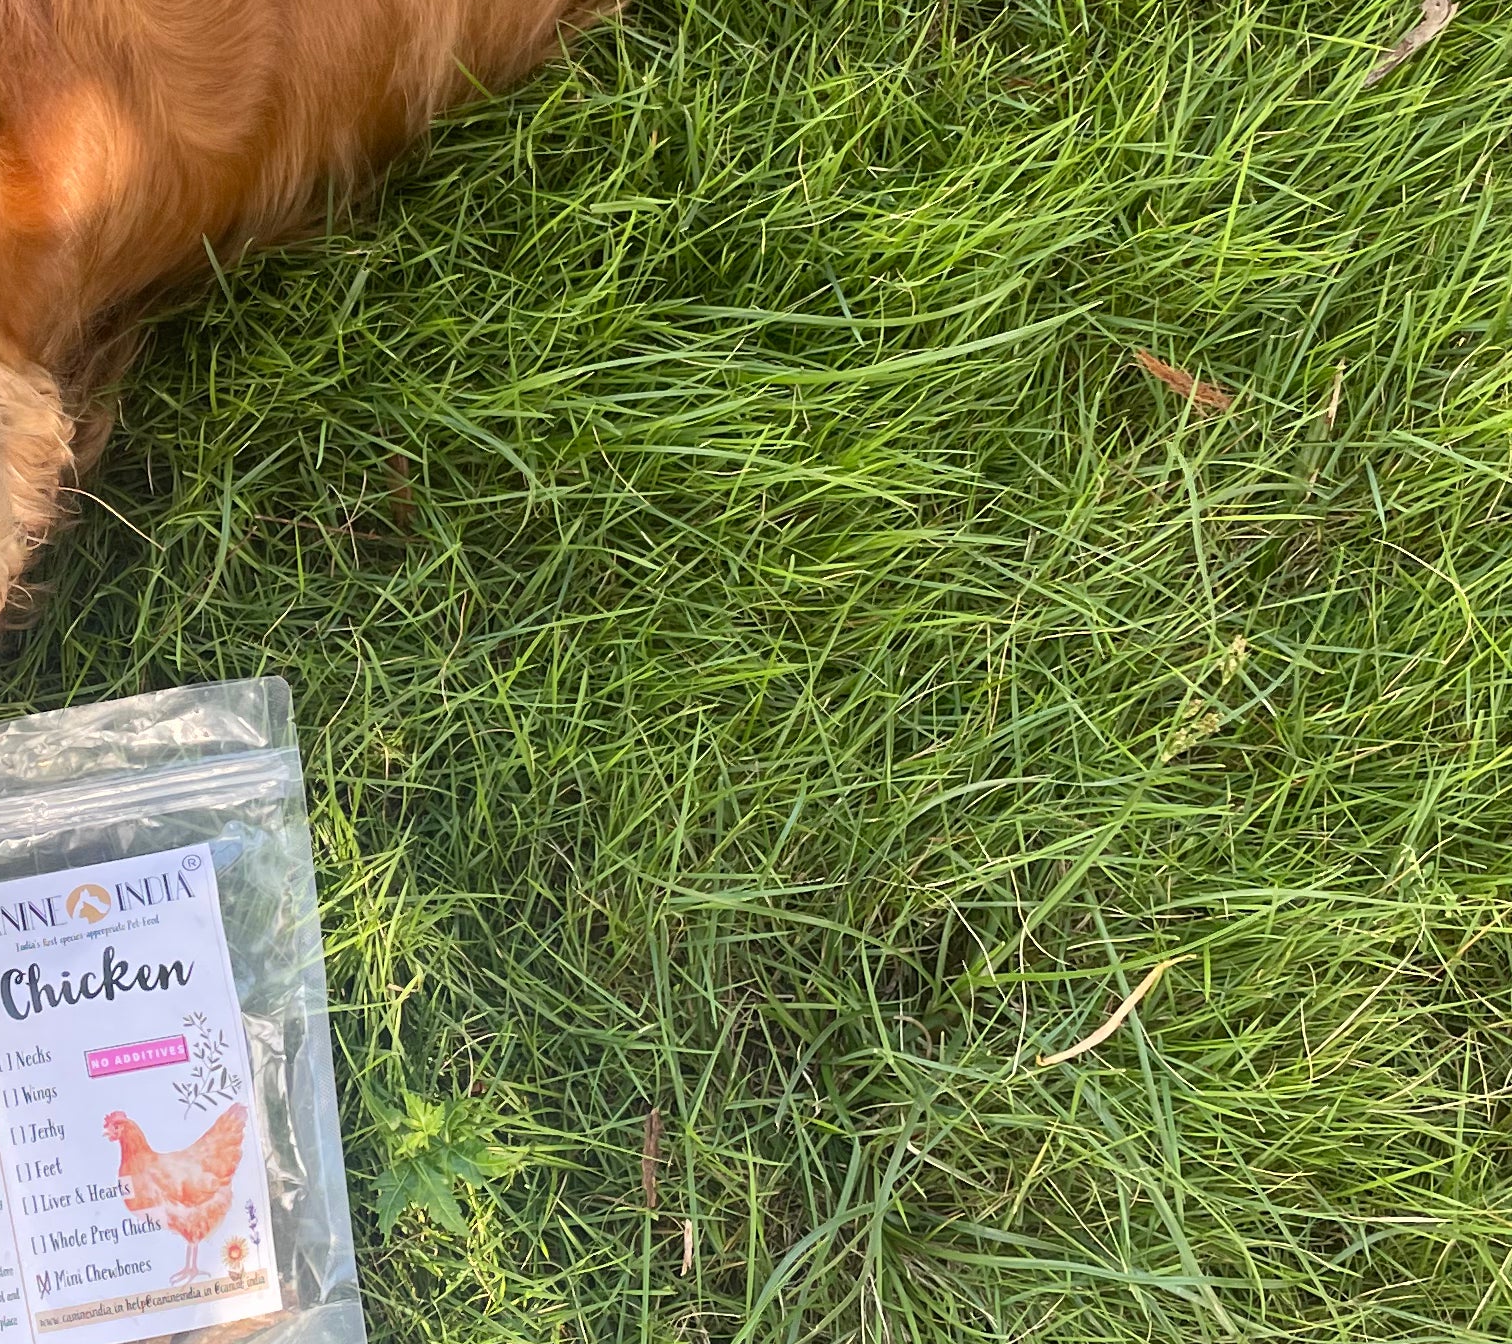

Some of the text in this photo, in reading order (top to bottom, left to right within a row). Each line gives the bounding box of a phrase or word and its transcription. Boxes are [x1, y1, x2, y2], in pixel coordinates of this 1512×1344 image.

[115, 869, 196, 912] INDIA
[0, 945, 195, 1020] Chicken
[15, 1044, 52, 1069] Necks
[90, 1044, 185, 1070] NO ADDITIVES
[21, 1084, 58, 1104] Wings
[29, 1118, 65, 1144] Jerky
[34, 1156, 64, 1178] Feet
[40, 1179, 131, 1213] Liver & Hearts
[49, 1213, 162, 1252] Whole Prey Chicks
[54, 1258, 153, 1291] Mini Chewbones
